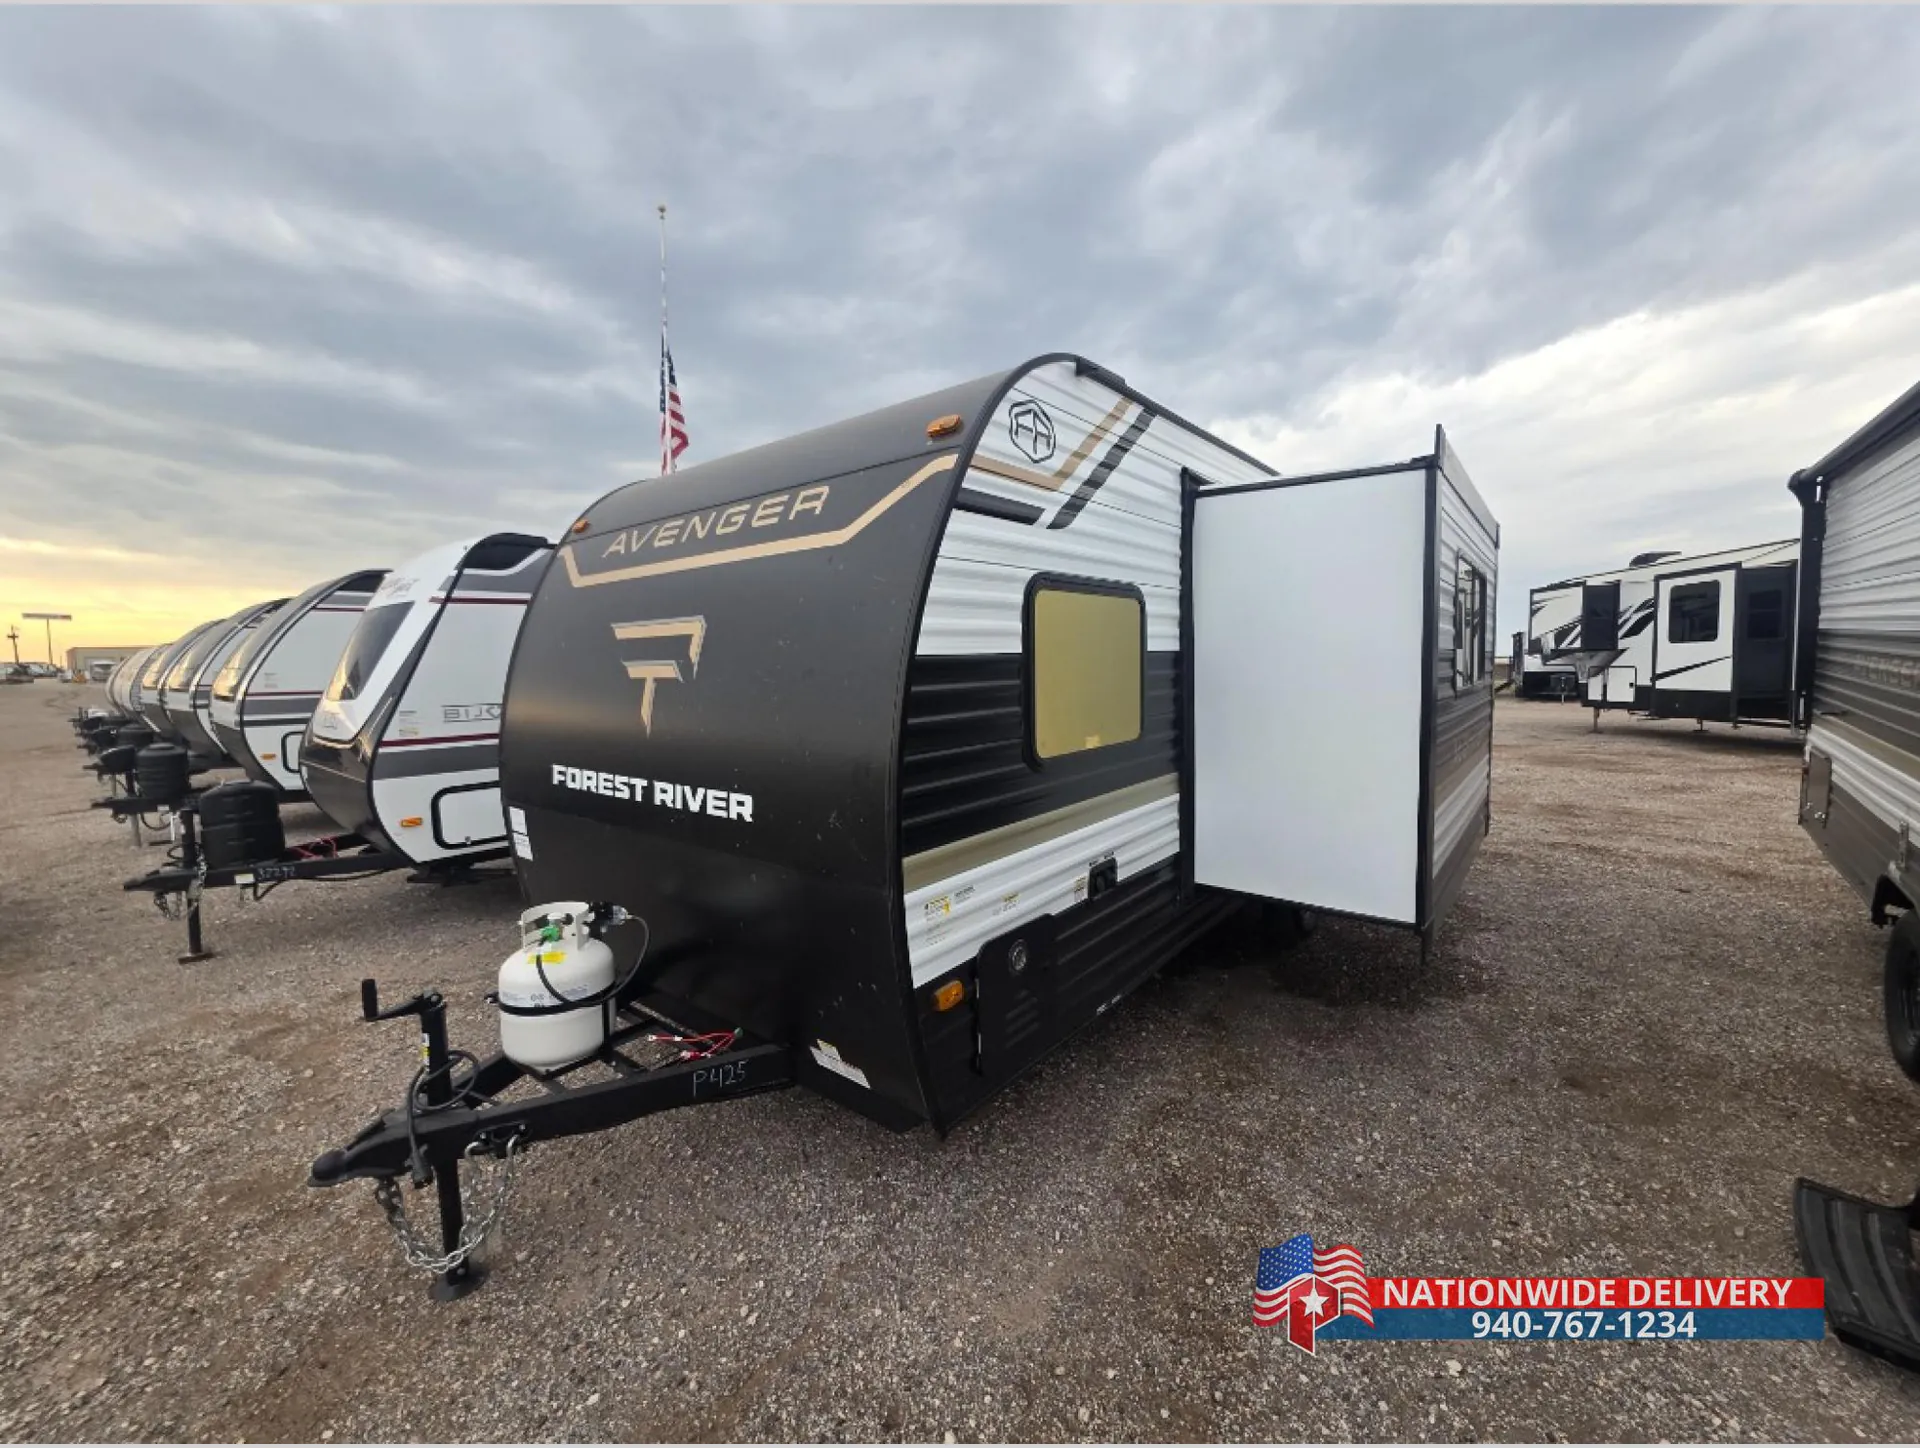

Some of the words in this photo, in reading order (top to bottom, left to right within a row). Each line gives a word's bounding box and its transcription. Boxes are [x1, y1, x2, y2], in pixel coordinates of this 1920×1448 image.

[602, 485, 830, 559] AVENGER
[552, 764, 648, 802] FOREST
[653, 780, 753, 822] RIVER
